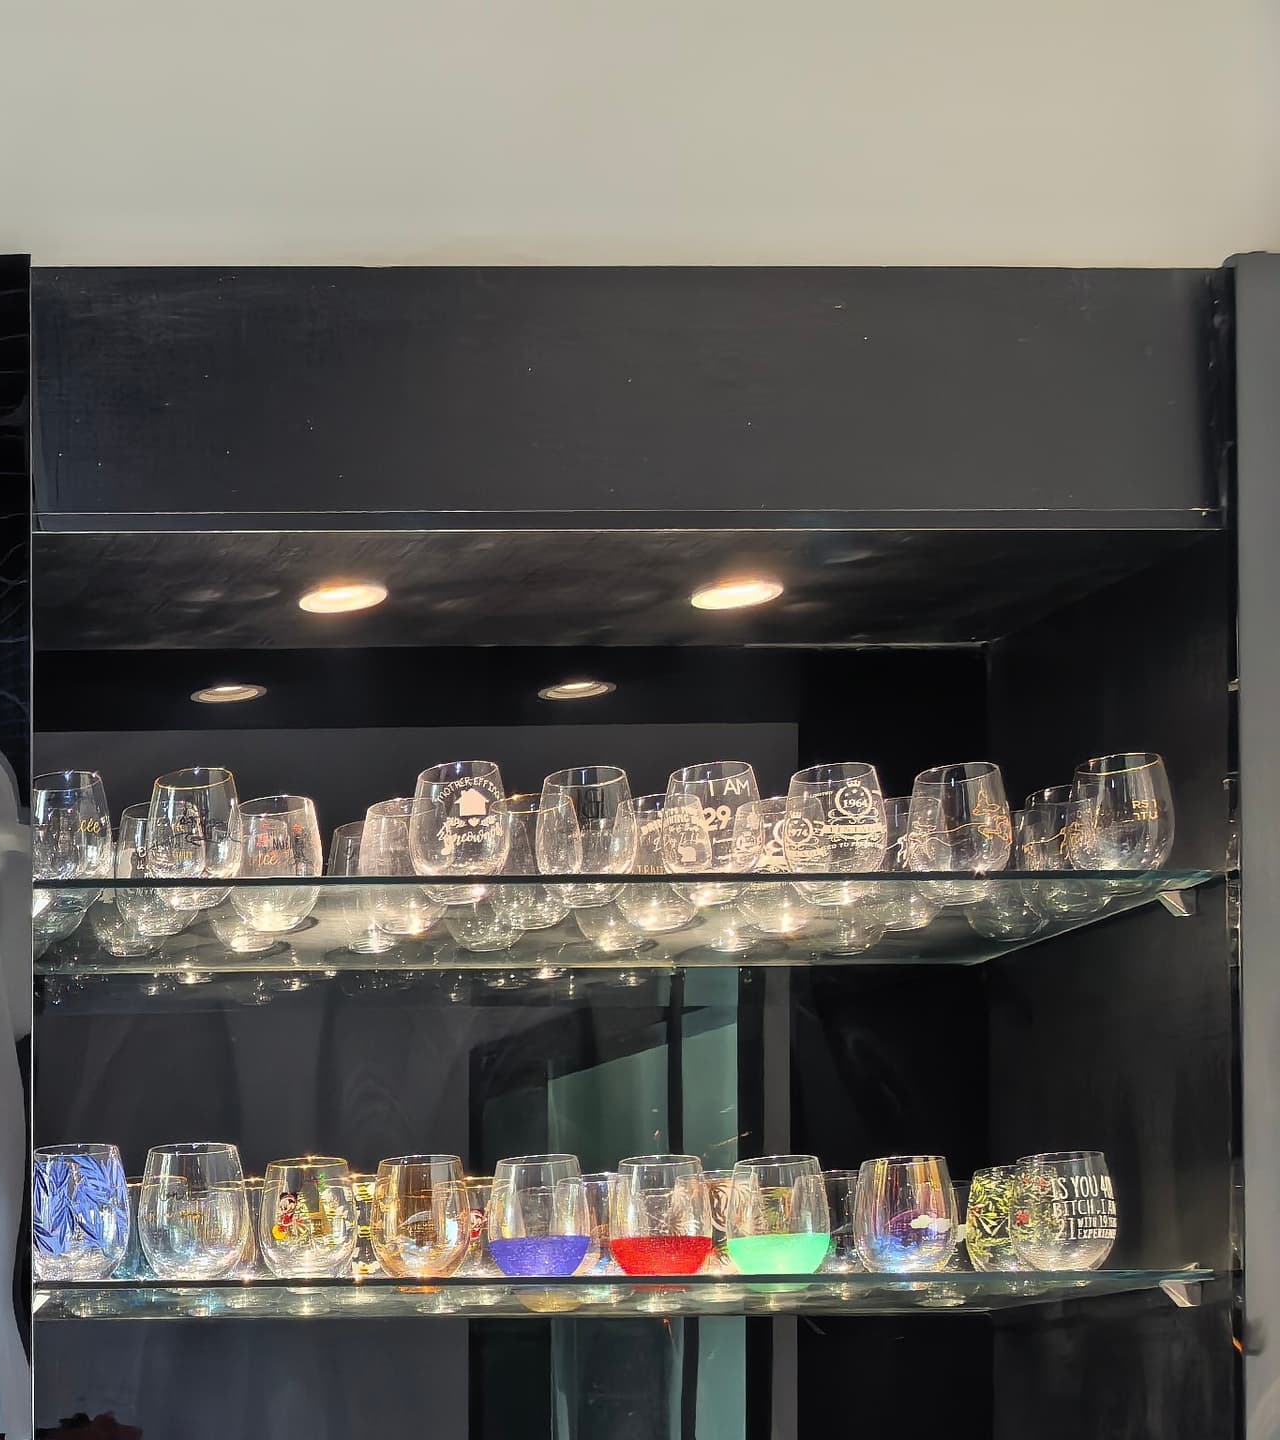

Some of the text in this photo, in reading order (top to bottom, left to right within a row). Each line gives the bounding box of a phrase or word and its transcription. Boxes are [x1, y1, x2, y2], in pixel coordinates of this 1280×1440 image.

[723, 779, 751, 796] AM
[843, 799, 869, 809] 1964
[702, 805, 732, 831] 29
[1071, 1175, 1098, 1198] YOU
